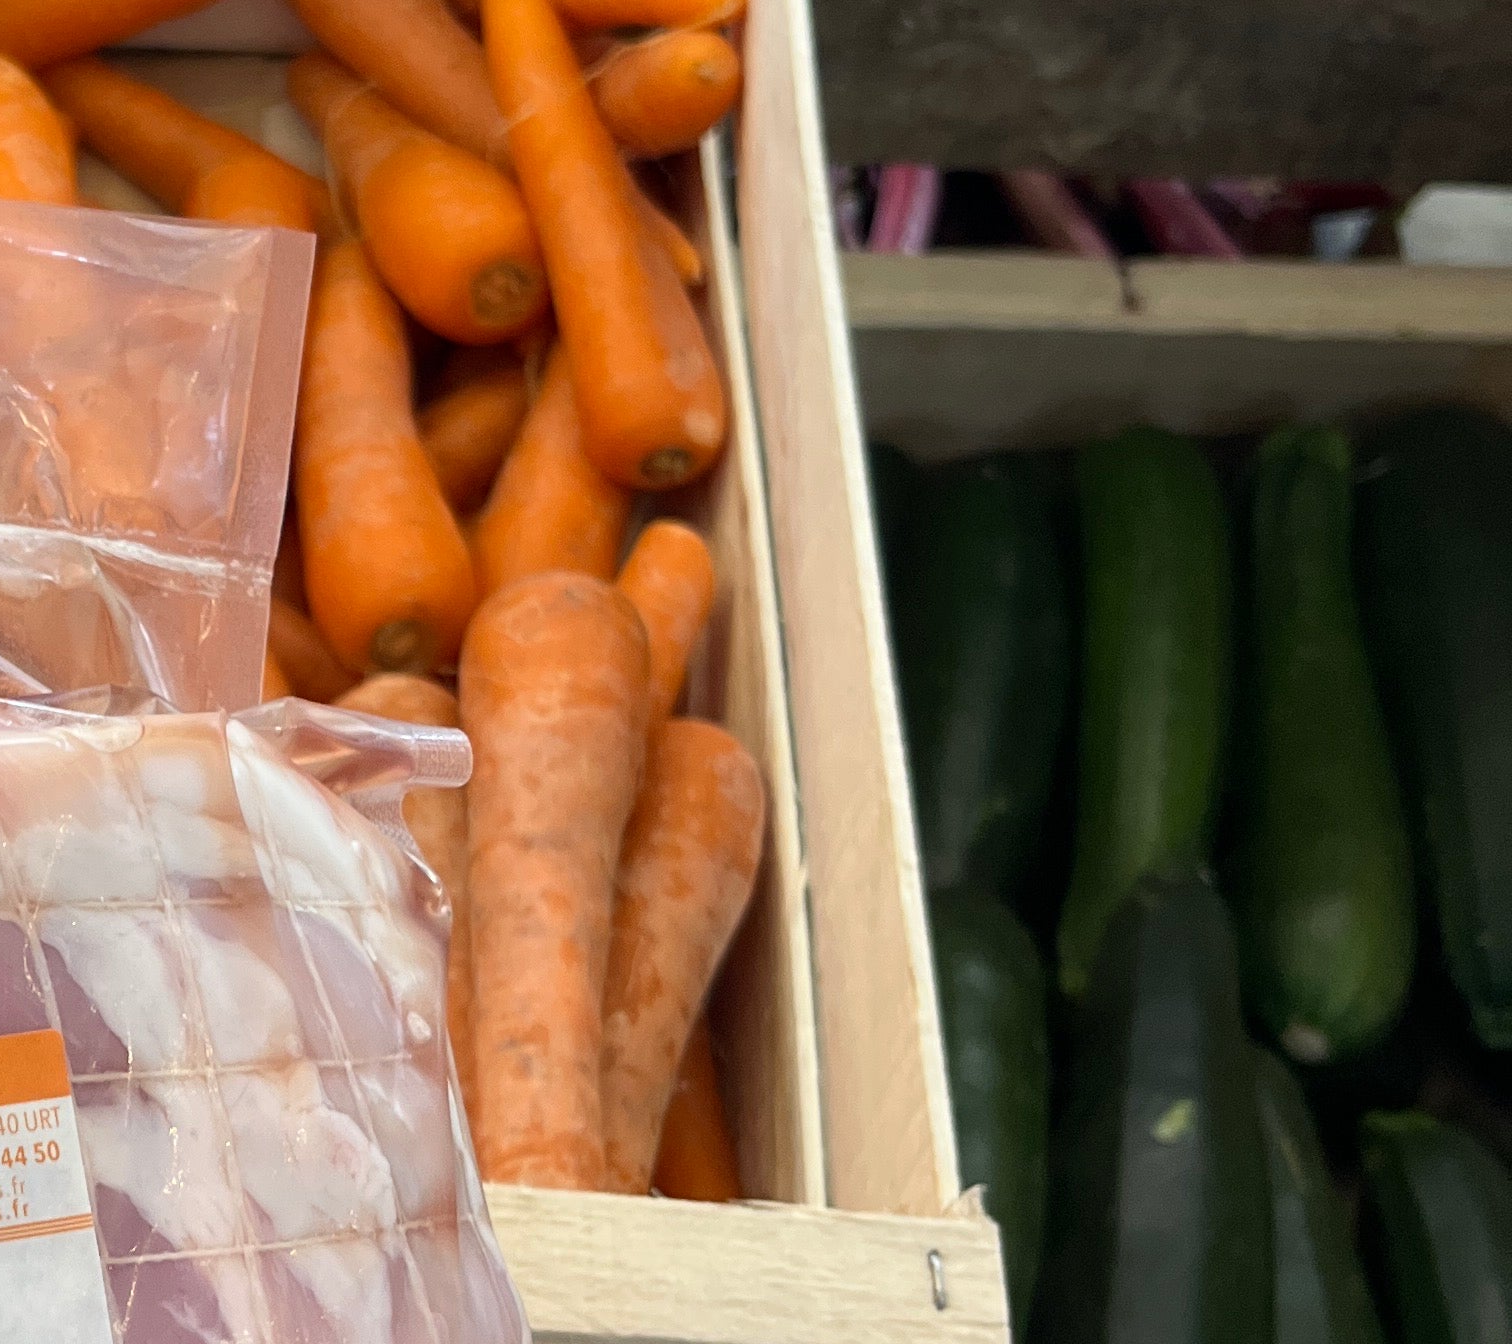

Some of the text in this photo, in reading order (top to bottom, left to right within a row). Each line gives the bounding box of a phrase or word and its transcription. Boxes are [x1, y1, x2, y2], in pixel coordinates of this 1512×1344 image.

[23, 1106, 61, 1133] URT
[1, 1145, 27, 1168] 44
[33, 1140, 61, 1163] 50
